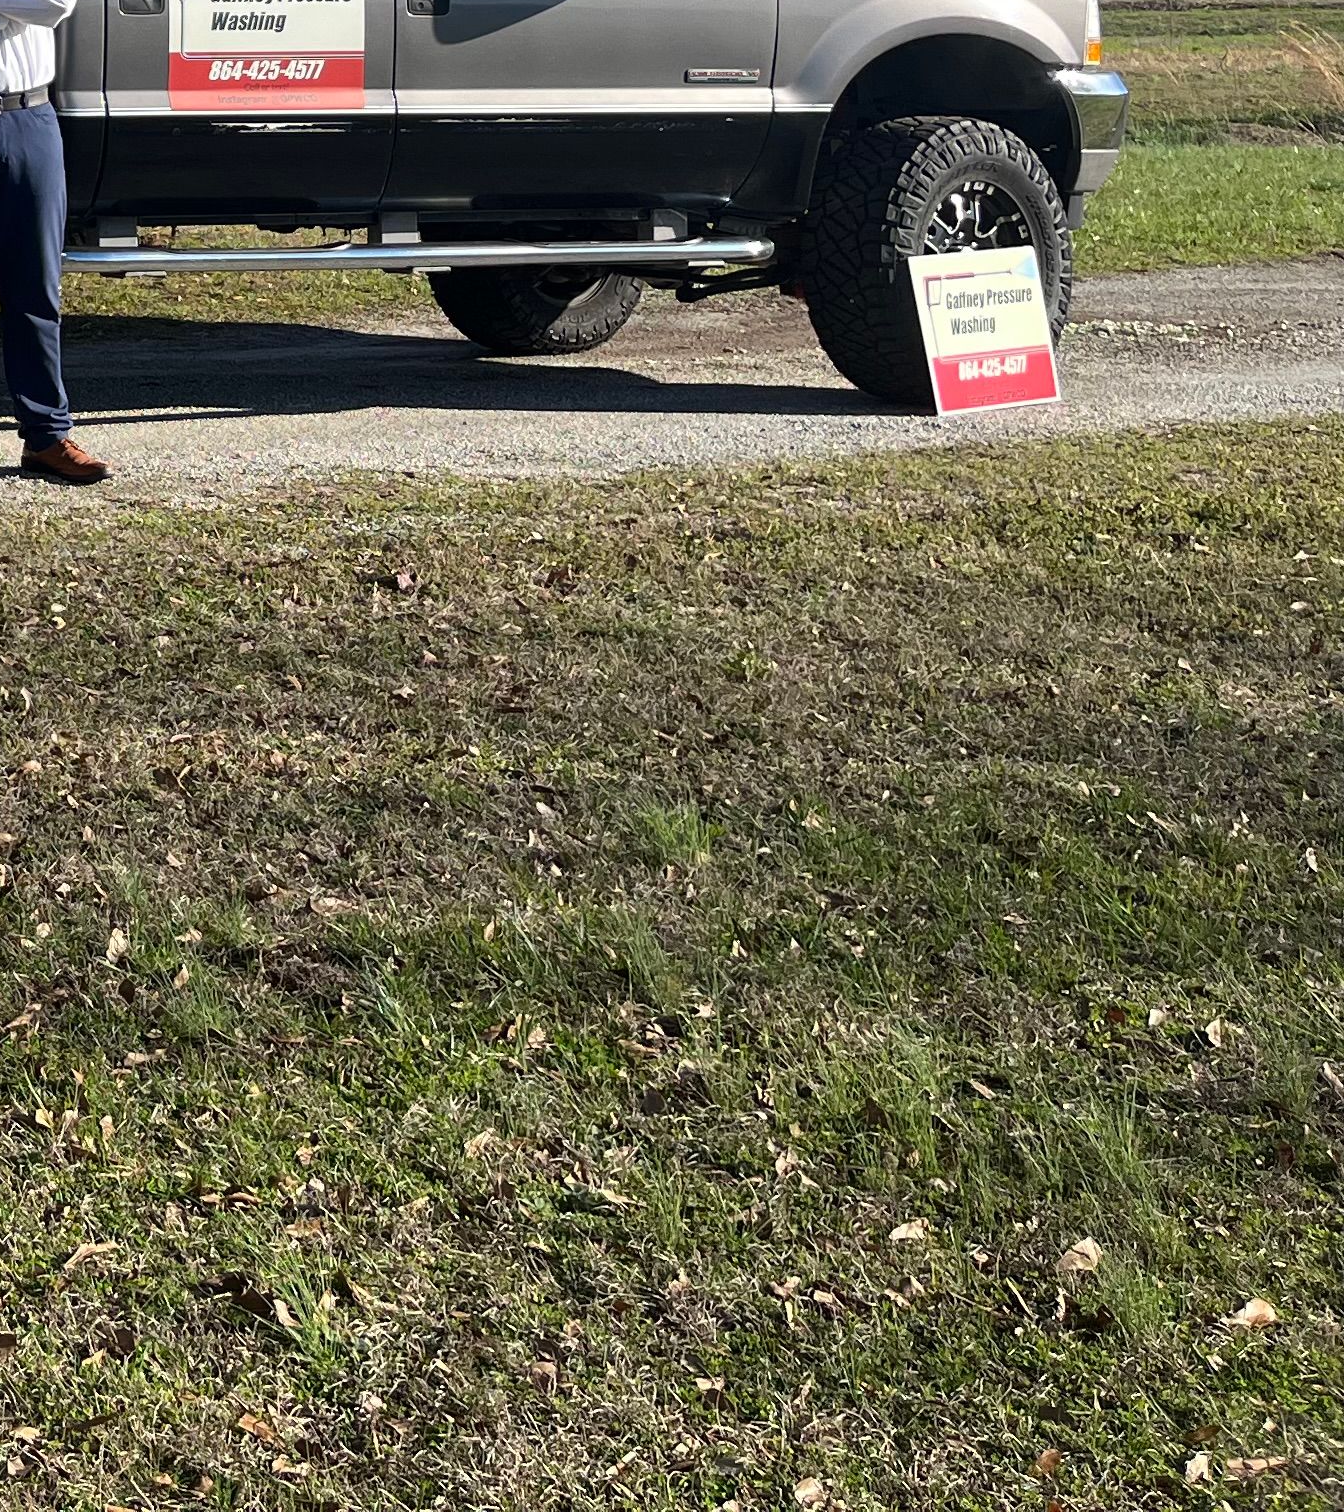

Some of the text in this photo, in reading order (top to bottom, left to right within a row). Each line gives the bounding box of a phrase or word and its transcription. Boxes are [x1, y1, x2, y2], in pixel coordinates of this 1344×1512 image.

[211, 11, 287, 33] Washing
[209, 60, 325, 81] 864-425-4577
[946, 287, 1032, 309] Gaffney Pressure
[950, 316, 996, 335] Washing
